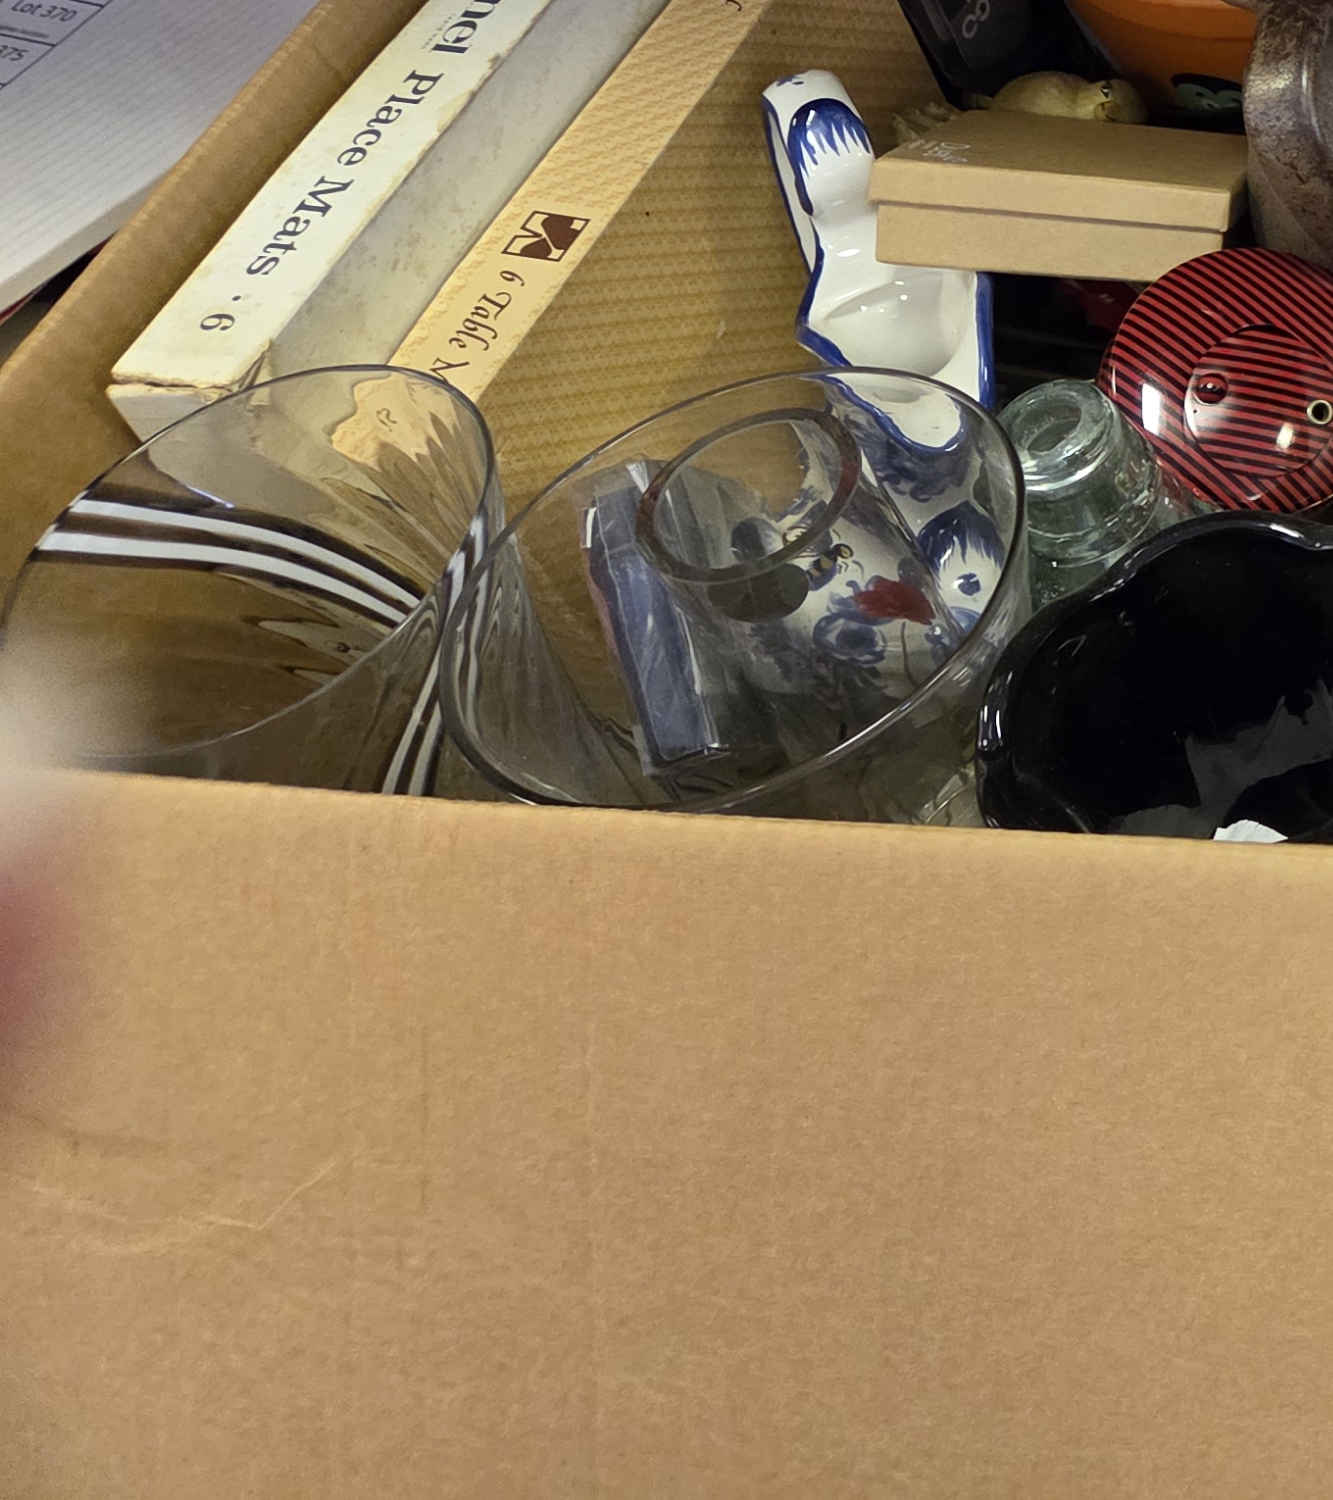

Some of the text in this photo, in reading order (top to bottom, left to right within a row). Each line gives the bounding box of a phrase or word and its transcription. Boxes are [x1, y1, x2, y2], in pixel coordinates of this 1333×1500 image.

[40, 2, 77, 26] 370
[200, 72, 444, 332] Place Mats 6
[449, 291, 512, 351] Table
